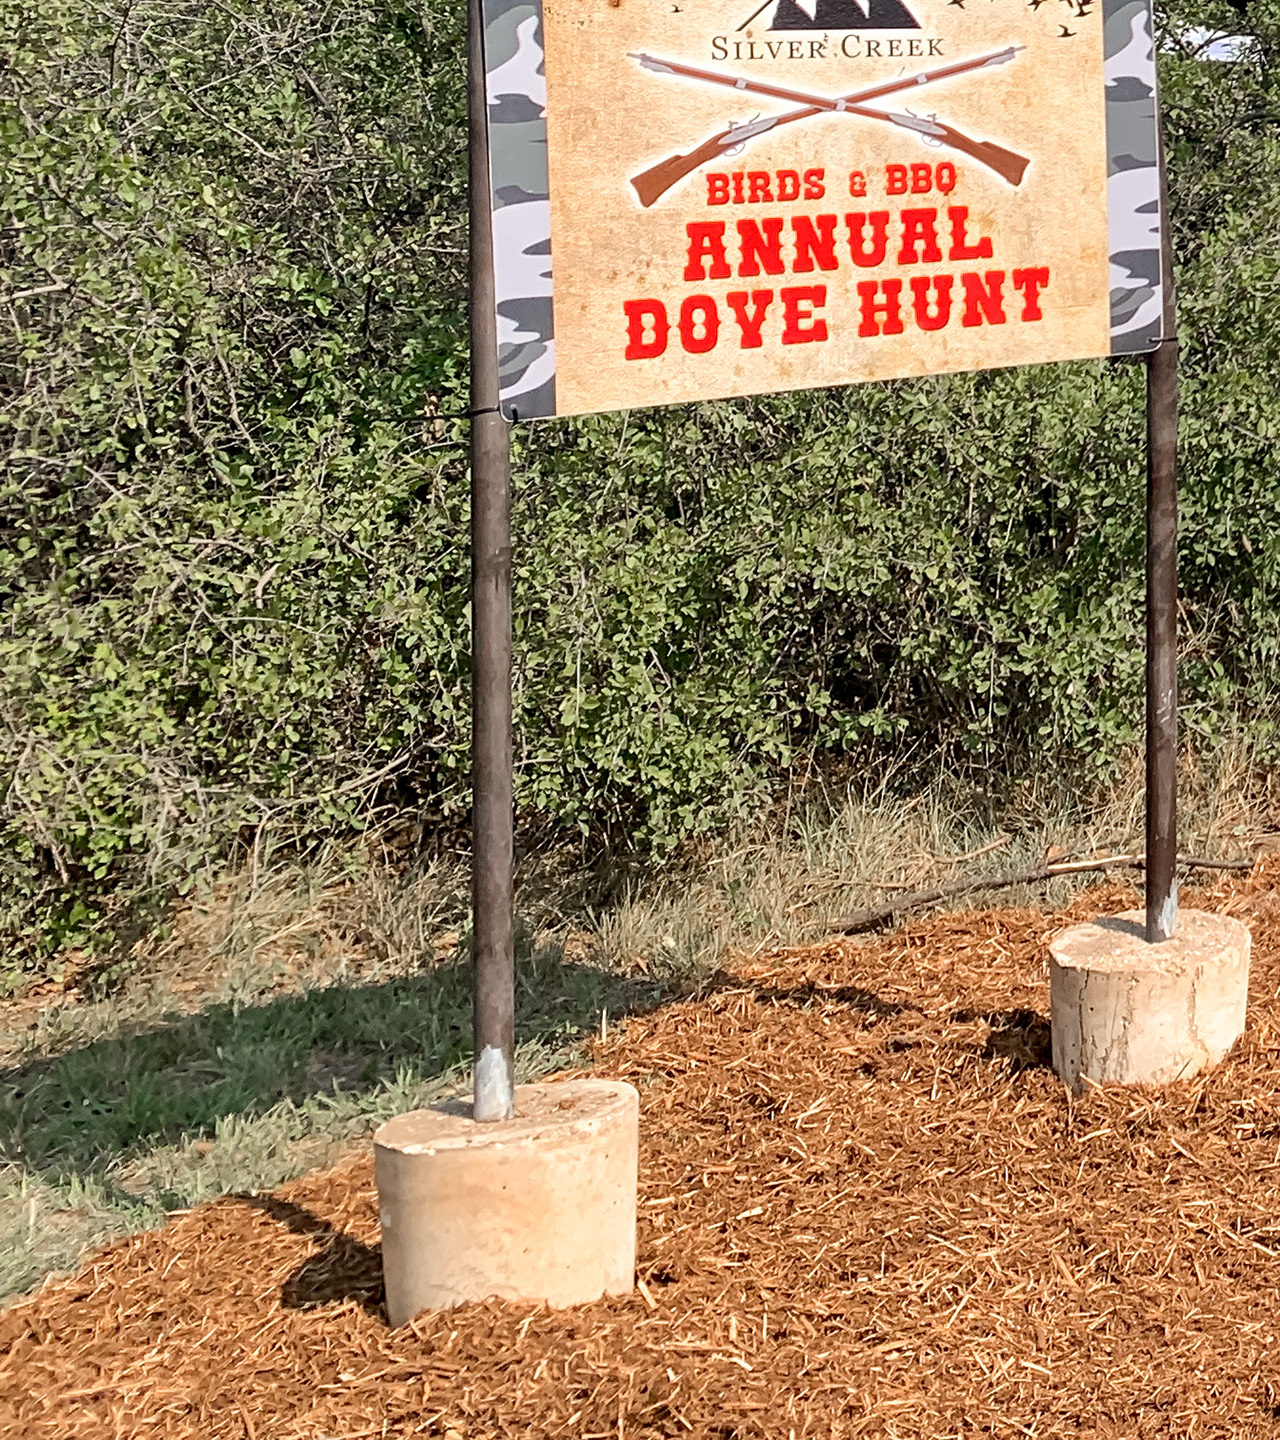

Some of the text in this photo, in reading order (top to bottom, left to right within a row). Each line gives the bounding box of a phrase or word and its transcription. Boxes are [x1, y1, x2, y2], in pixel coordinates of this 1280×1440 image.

[706, 161, 957, 205] BIRDS & BBQ
[683, 206, 994, 282] ANNUAL
[623, 266, 1050, 361] DOVE HUNT
